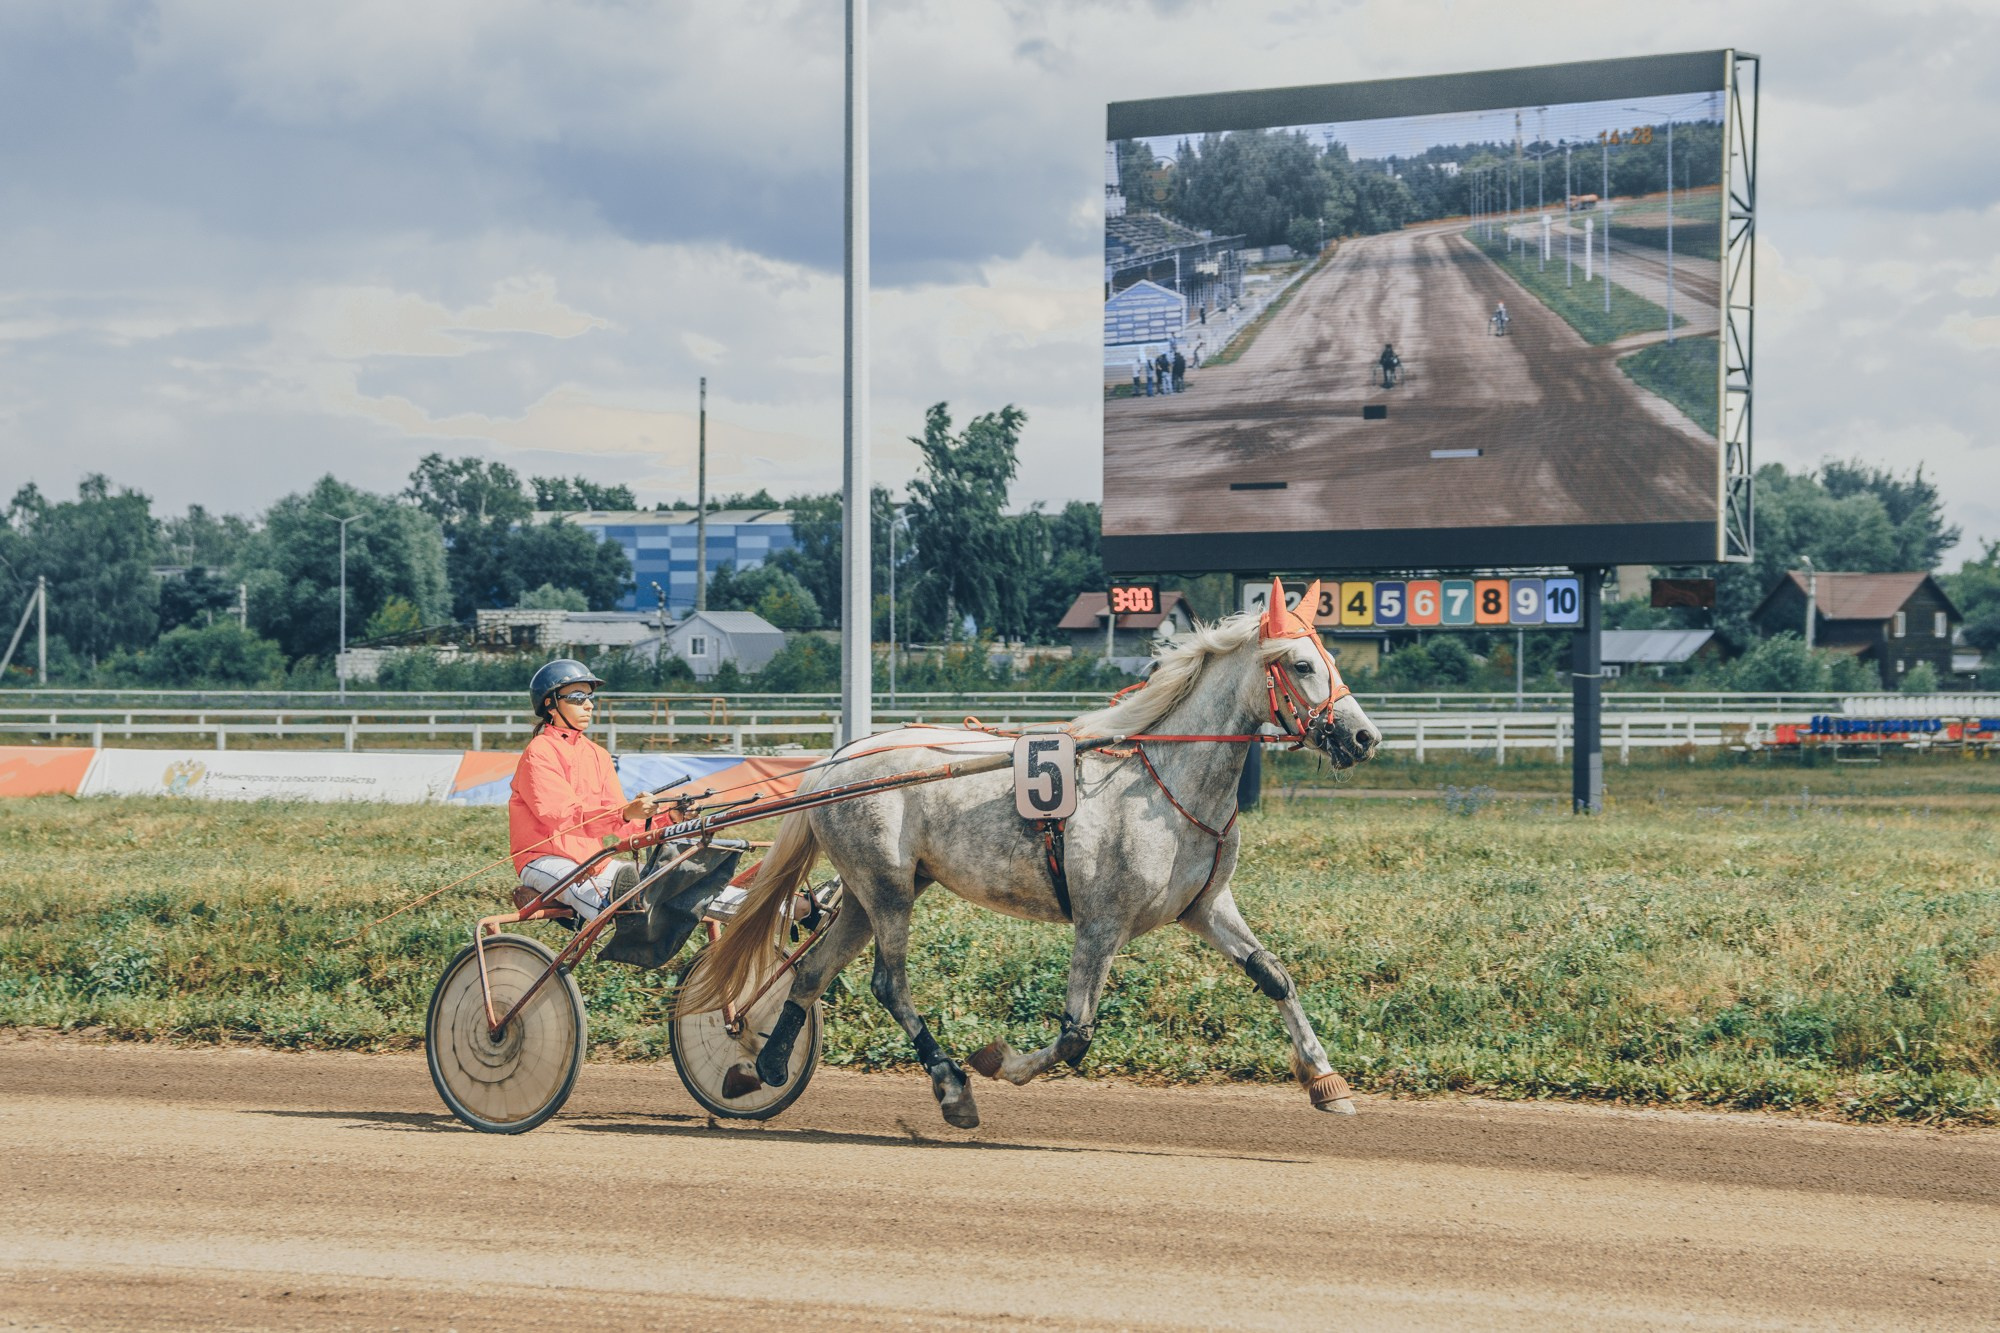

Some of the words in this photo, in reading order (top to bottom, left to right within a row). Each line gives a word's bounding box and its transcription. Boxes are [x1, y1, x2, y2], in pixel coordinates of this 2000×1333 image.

[1112, 587, 1154, 612] 3:00
[1317, 591, 1333, 617] 3
[1347, 591, 1367, 616] 4
[1379, 590, 1401, 617] 5
[1414, 589, 1435, 616] 6
[1446, 588, 1469, 616] 7
[1482, 588, 1502, 615] 8
[1516, 587, 1539, 615] 9
[1547, 587, 1577, 615] 10
[1028, 740, 1063, 812] 5
